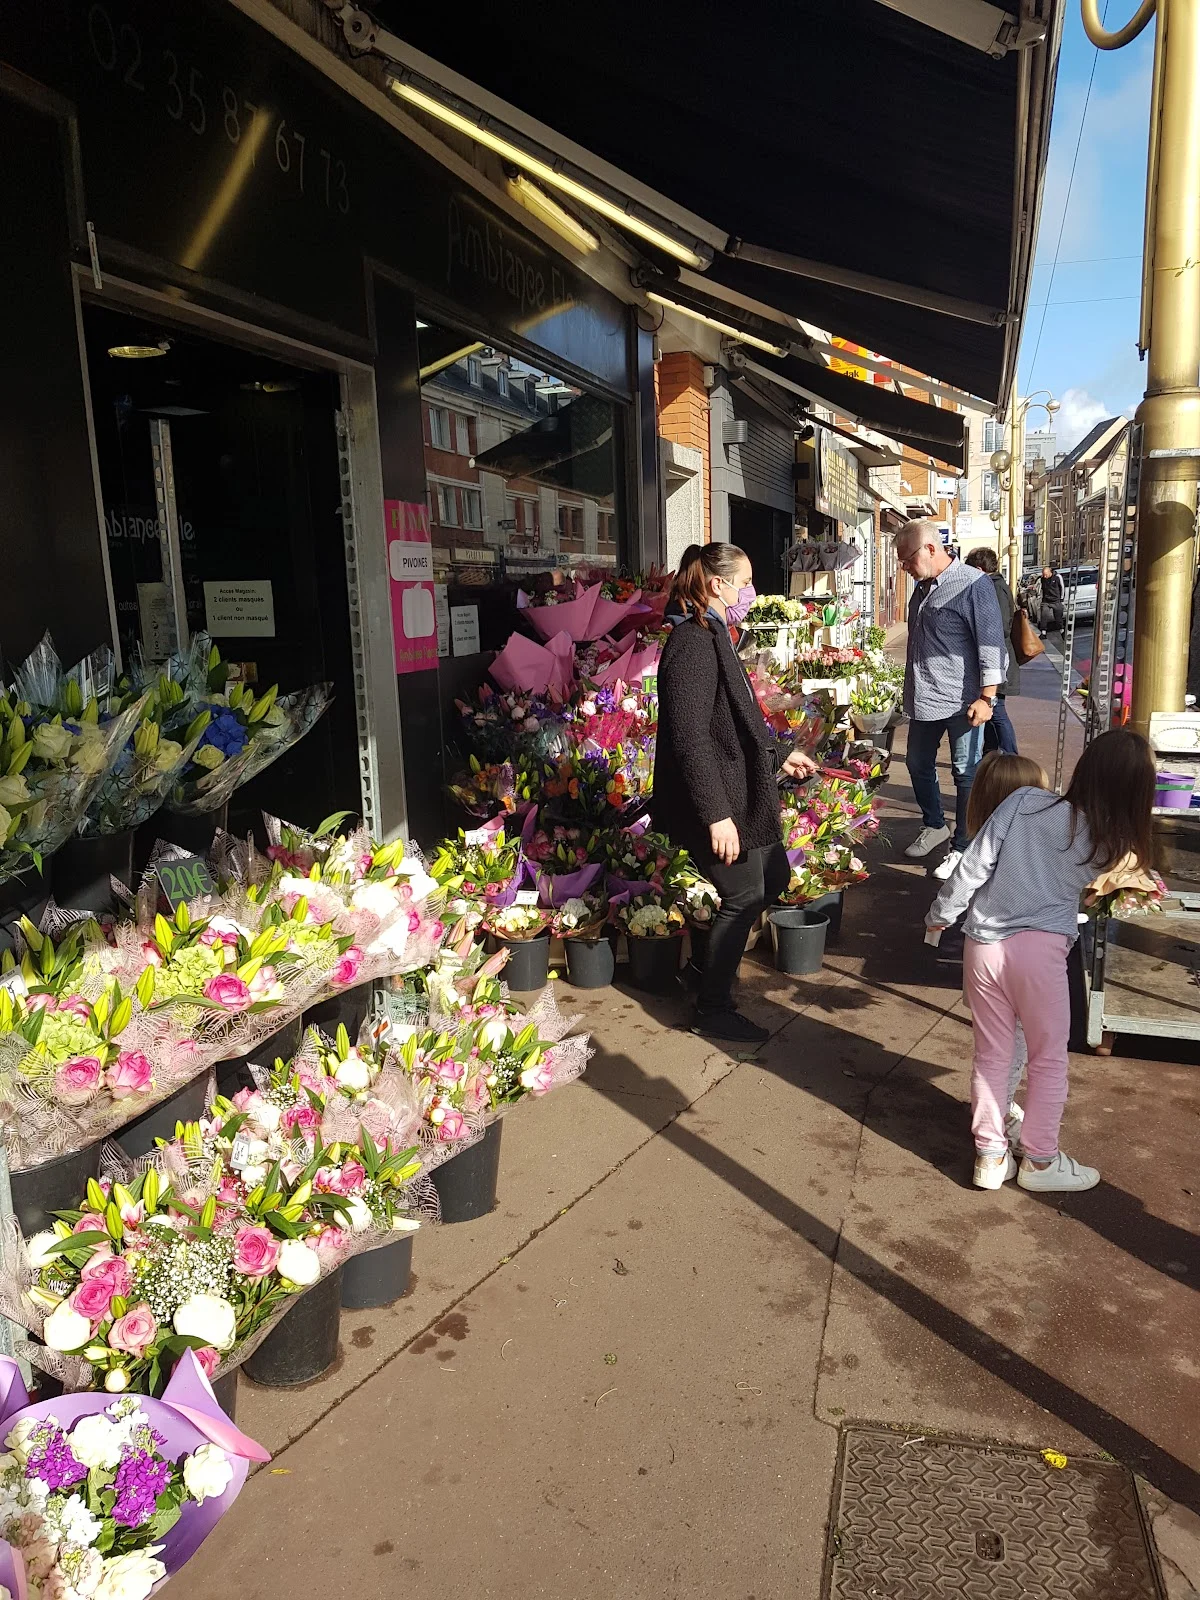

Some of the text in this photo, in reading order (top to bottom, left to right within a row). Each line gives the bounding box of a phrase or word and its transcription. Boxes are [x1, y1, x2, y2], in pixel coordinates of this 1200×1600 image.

[88, 3, 143, 91] 02
[160, 47, 205, 137] 35
[275, 119, 304, 195] 67
[319, 147, 349, 215] 73
[402, 556, 428, 570] PIVOINES
[160, 862, 214, 900] 20€
